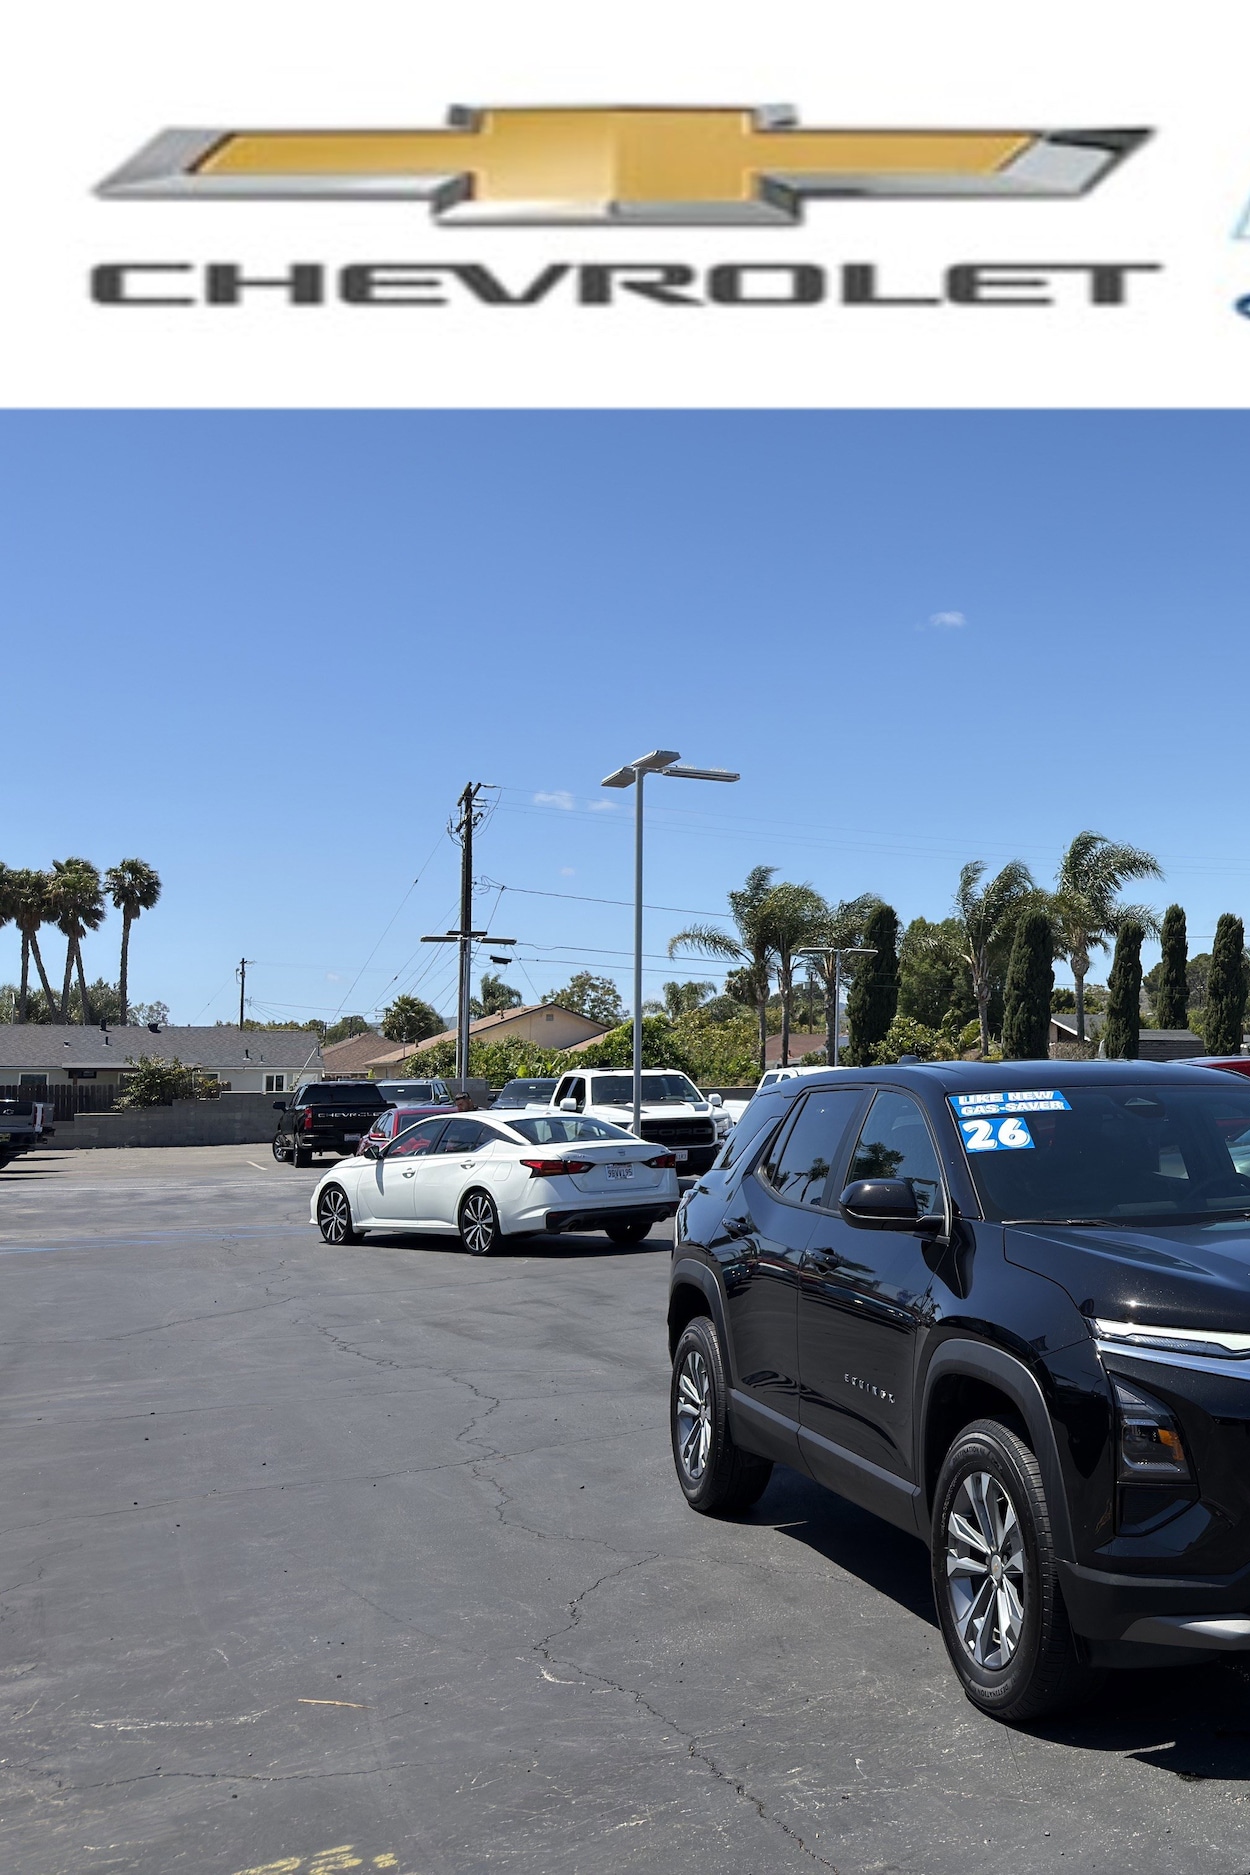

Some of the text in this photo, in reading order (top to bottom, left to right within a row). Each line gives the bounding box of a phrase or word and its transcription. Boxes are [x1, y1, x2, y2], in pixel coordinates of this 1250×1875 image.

[958, 1090, 1055, 1106] LIKE NEW
[318, 1111, 384, 1119] CHEVROLE
[961, 1100, 1065, 1116] GAS-SAVER
[641, 1127, 712, 1136] FORD
[962, 1117, 1031, 1150] 26
